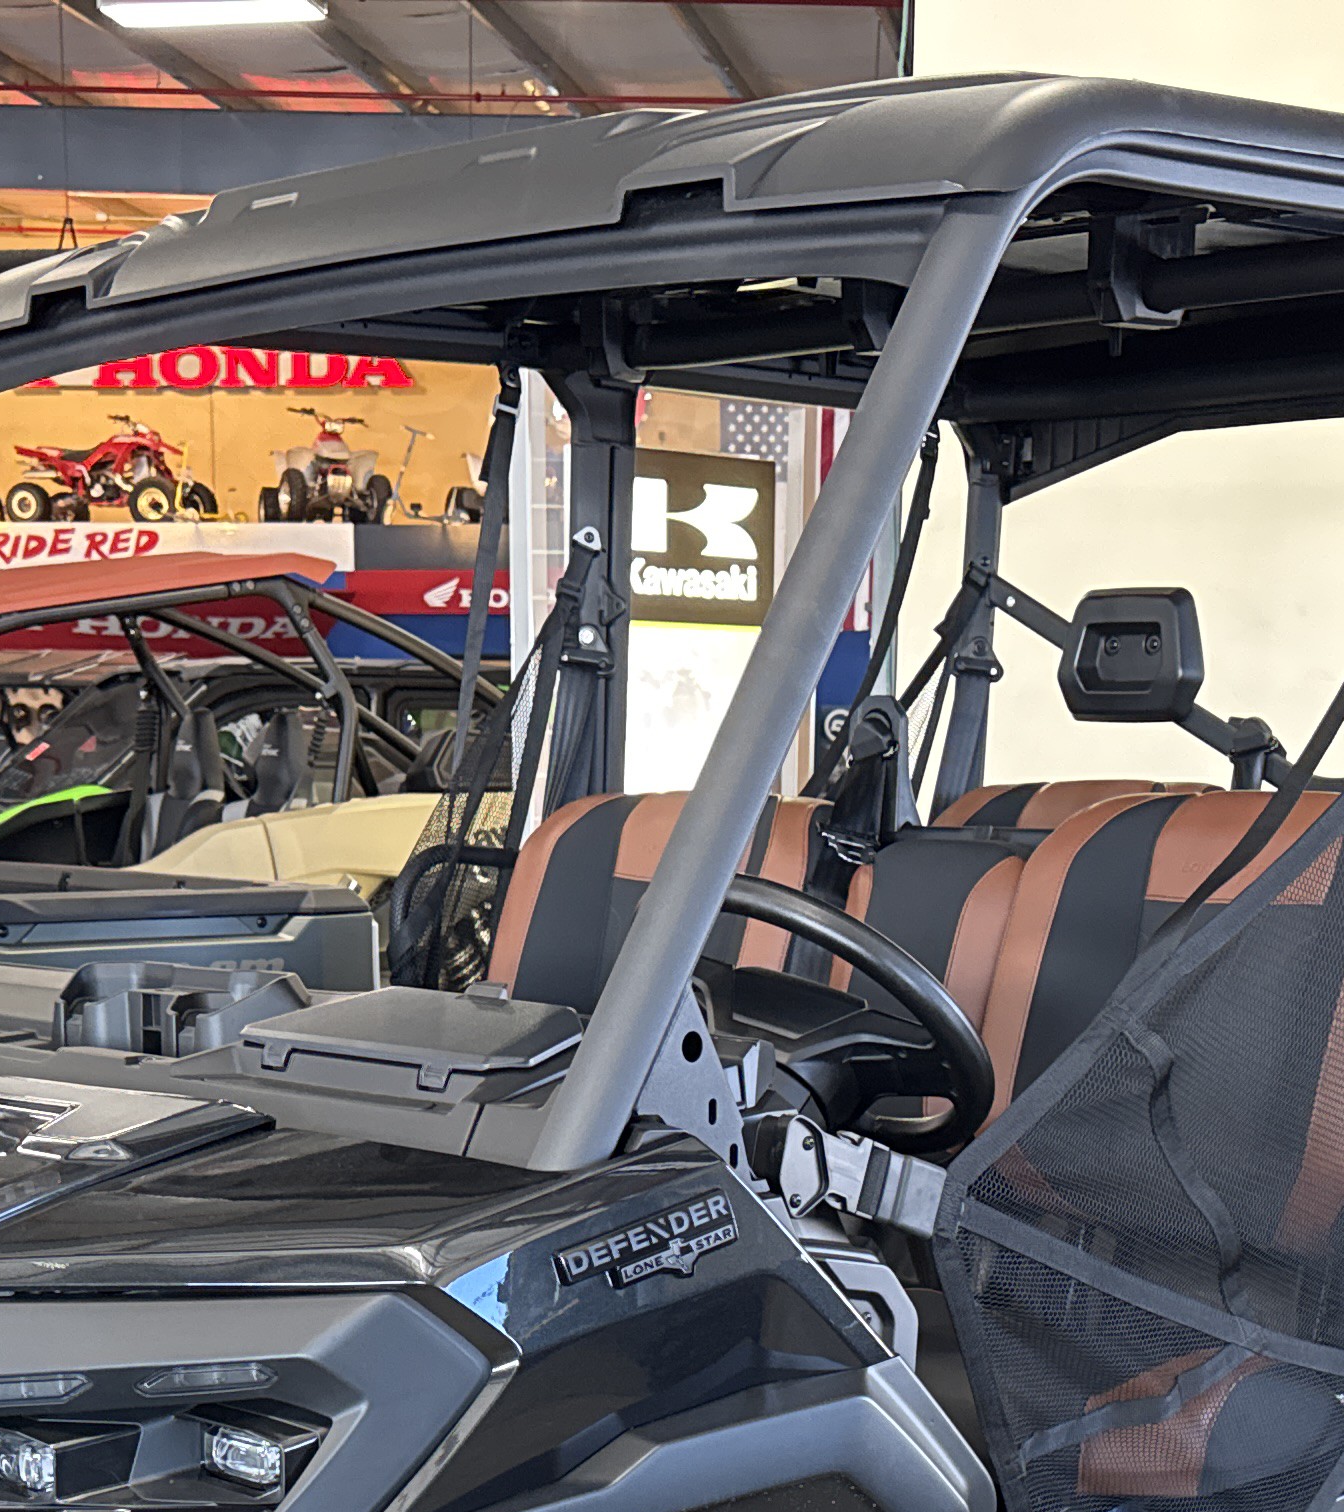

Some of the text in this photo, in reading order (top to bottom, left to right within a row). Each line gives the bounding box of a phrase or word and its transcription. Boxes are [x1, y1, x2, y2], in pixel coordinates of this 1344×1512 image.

[92, 345, 414, 388] HONDA
[84, 529, 159, 559] RED
[630, 557, 757, 601] Kawasaki
[567, 1194, 729, 1276] DEFENDER
[623, 1226, 734, 1281] LONE STAR
